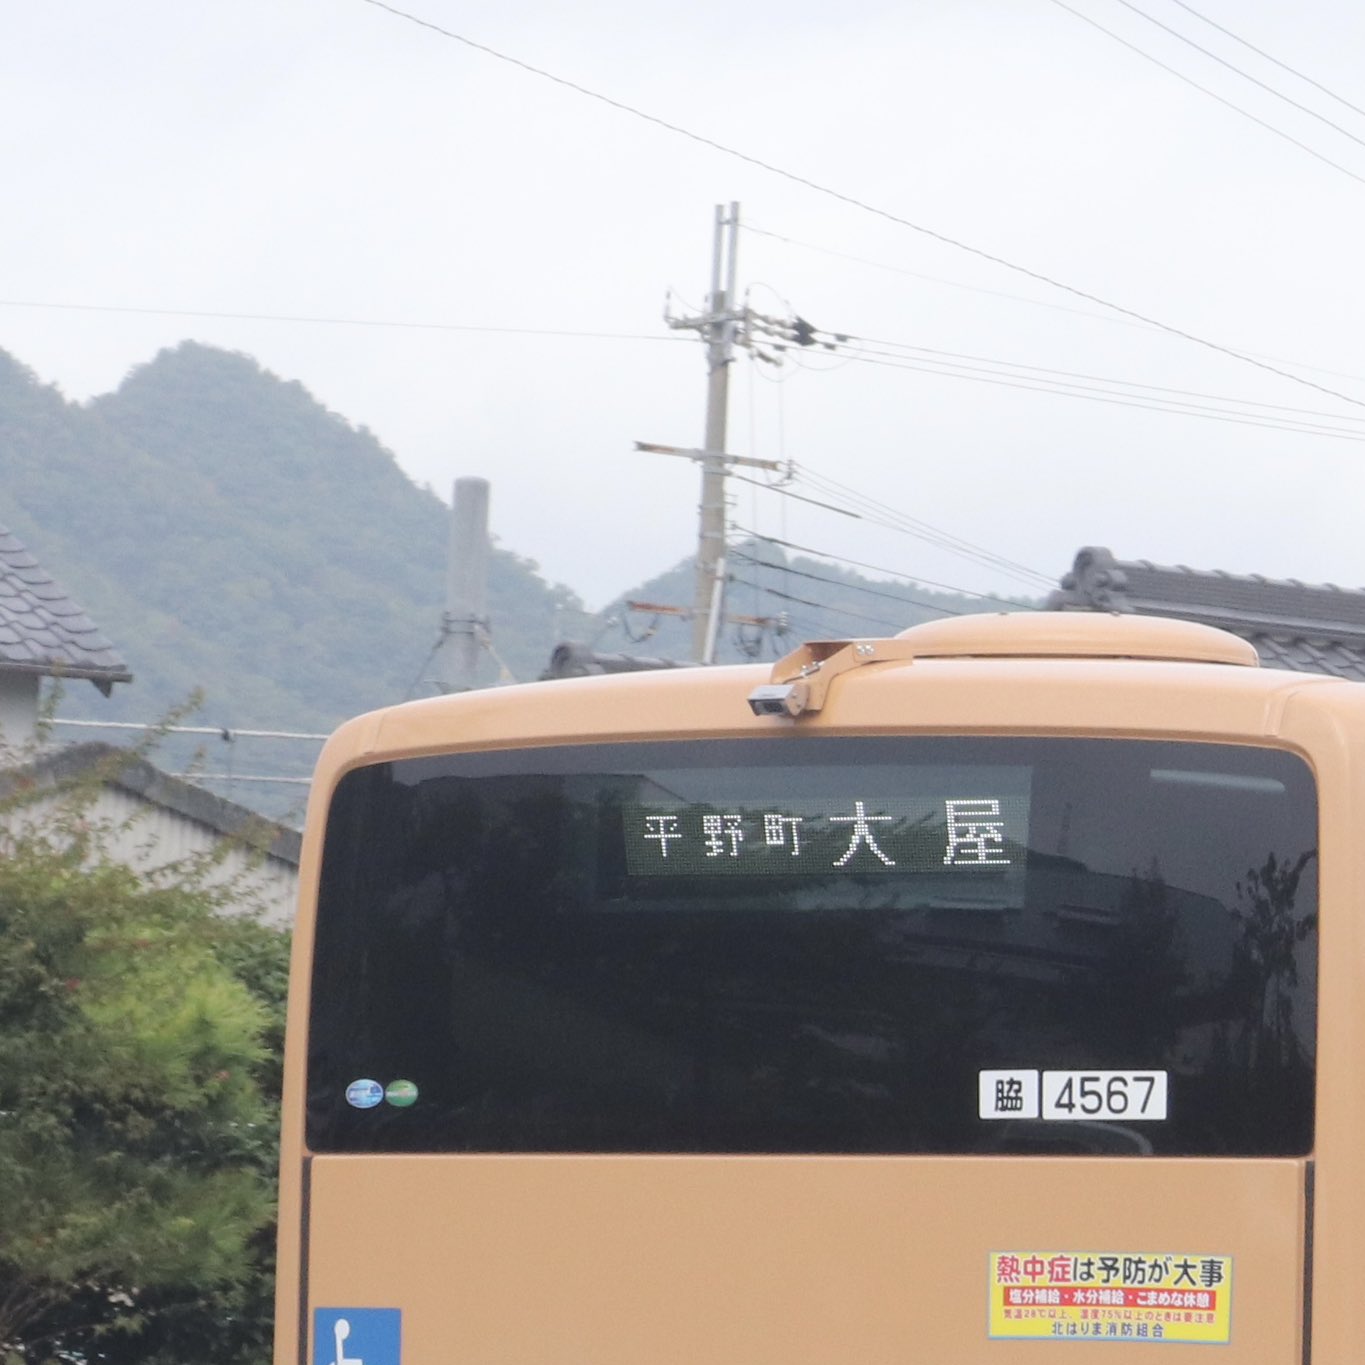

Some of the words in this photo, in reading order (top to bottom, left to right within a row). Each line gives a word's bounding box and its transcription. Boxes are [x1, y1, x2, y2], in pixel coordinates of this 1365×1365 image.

[644, 814, 803, 858] 平野町
[829, 800, 1012, 867] 大屋
[1054, 1076, 1156, 1114] 4567
[997, 1255, 1225, 1288] 熱中症は予防が大事
[1051, 1321, 1165, 1338] 北はりま消防組合
